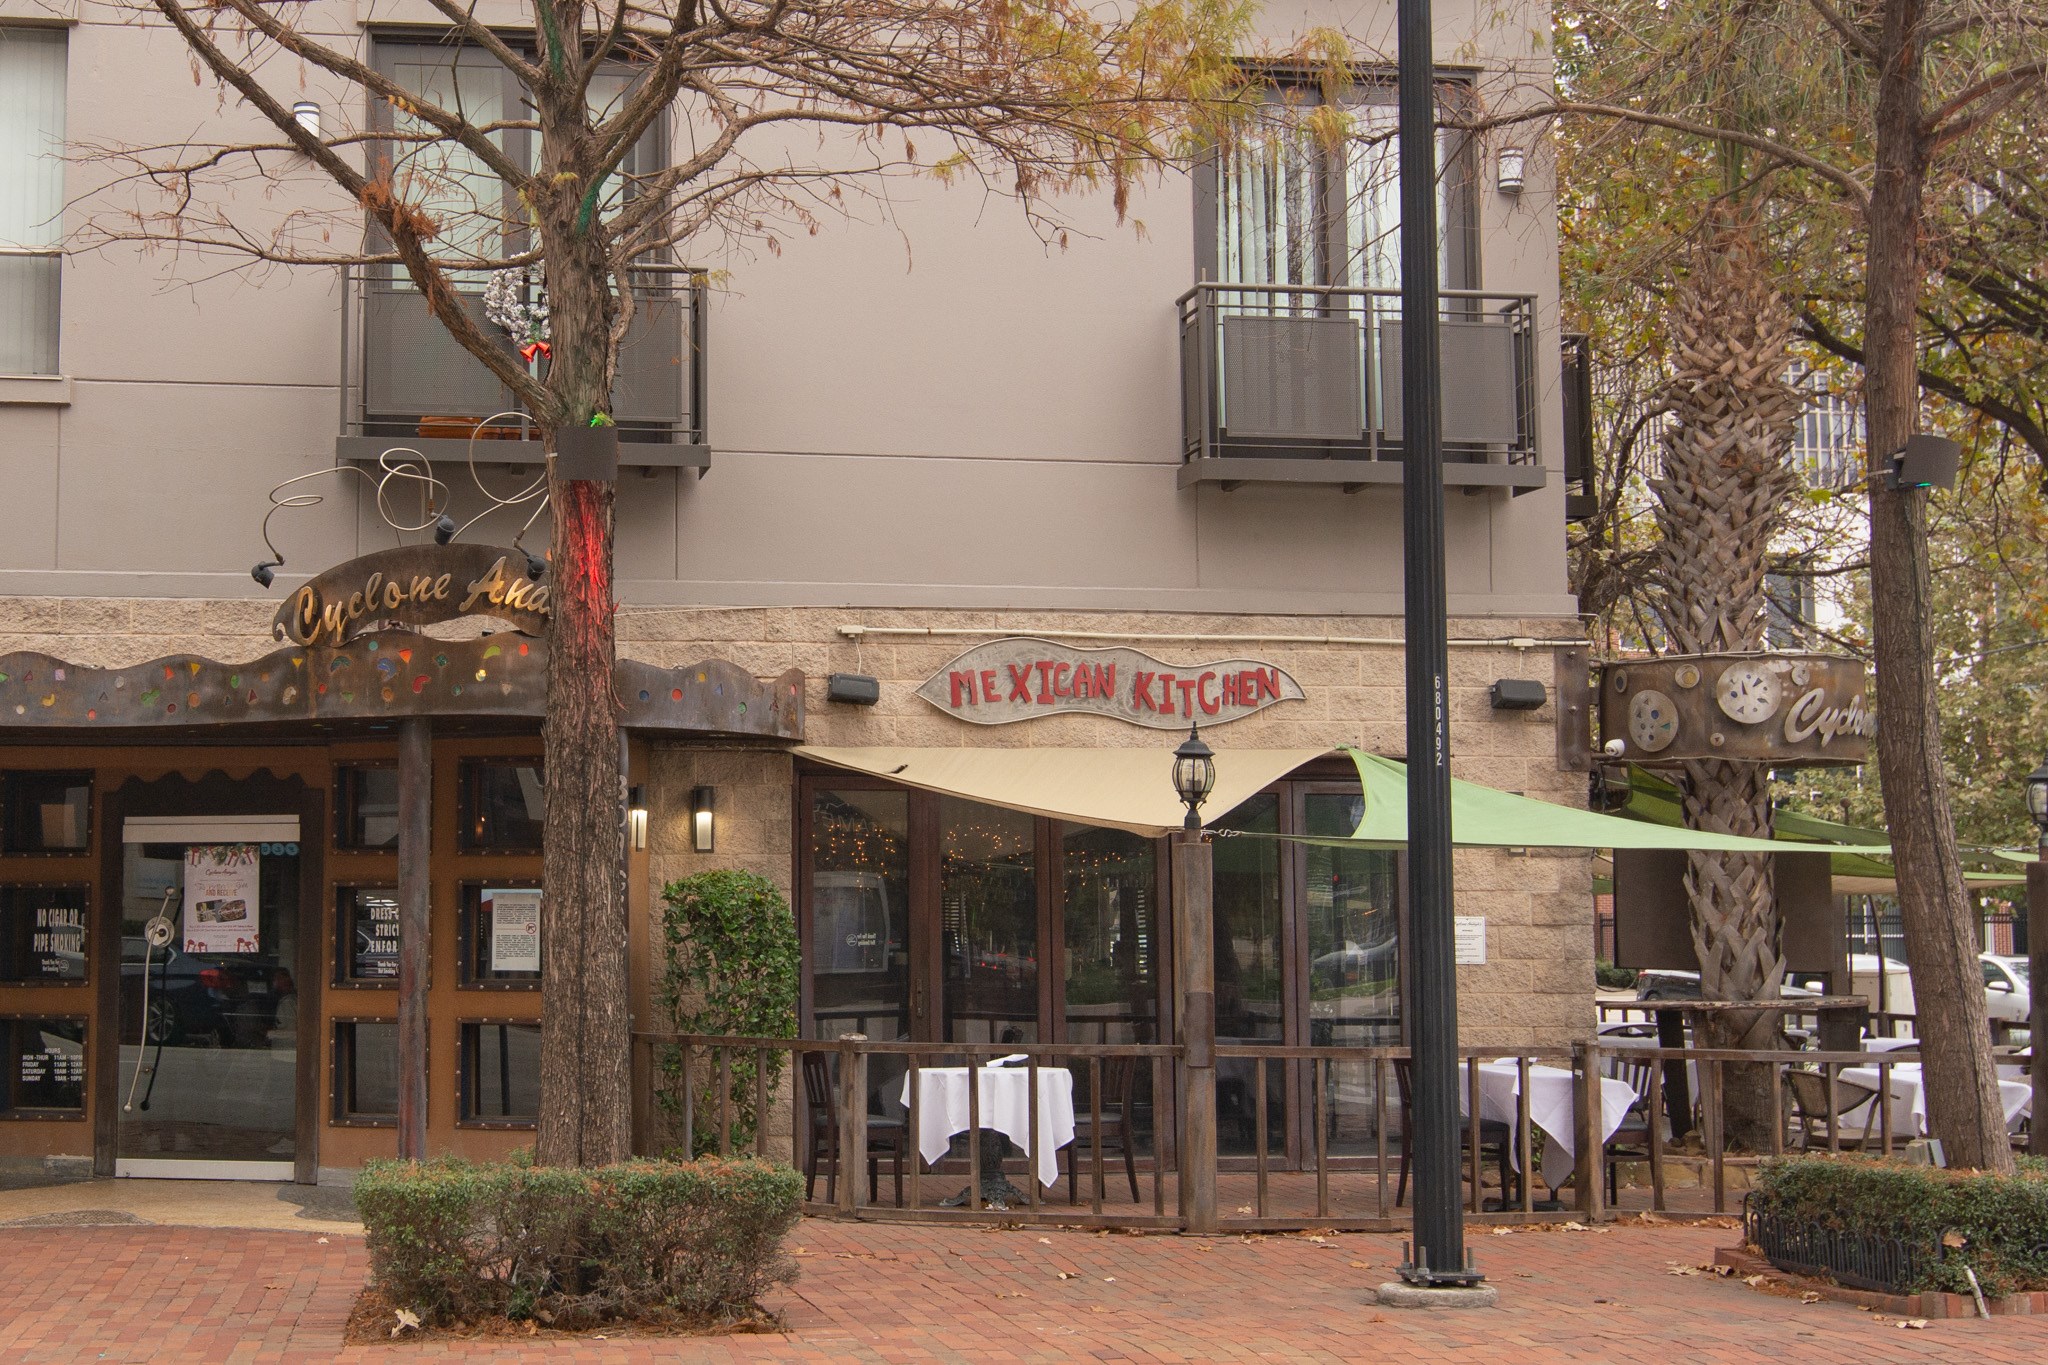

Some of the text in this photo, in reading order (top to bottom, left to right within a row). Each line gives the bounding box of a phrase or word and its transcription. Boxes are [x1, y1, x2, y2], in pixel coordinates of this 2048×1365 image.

[294, 556, 551, 646] Cyclone Ana
[949, 660, 1281, 718] MEXICAN KITCHEN
[1434, 675, 1443, 766] 680492
[1784, 687, 1877, 748] Cyclon
[37, 908, 79, 928] NO CIGAR OR
[370, 907, 392, 920] DRESS
[375, 923, 400, 937] STRICT
[33, 933, 81, 953] PIPE SMOKING
[370, 940, 398, 953] ENFOR
